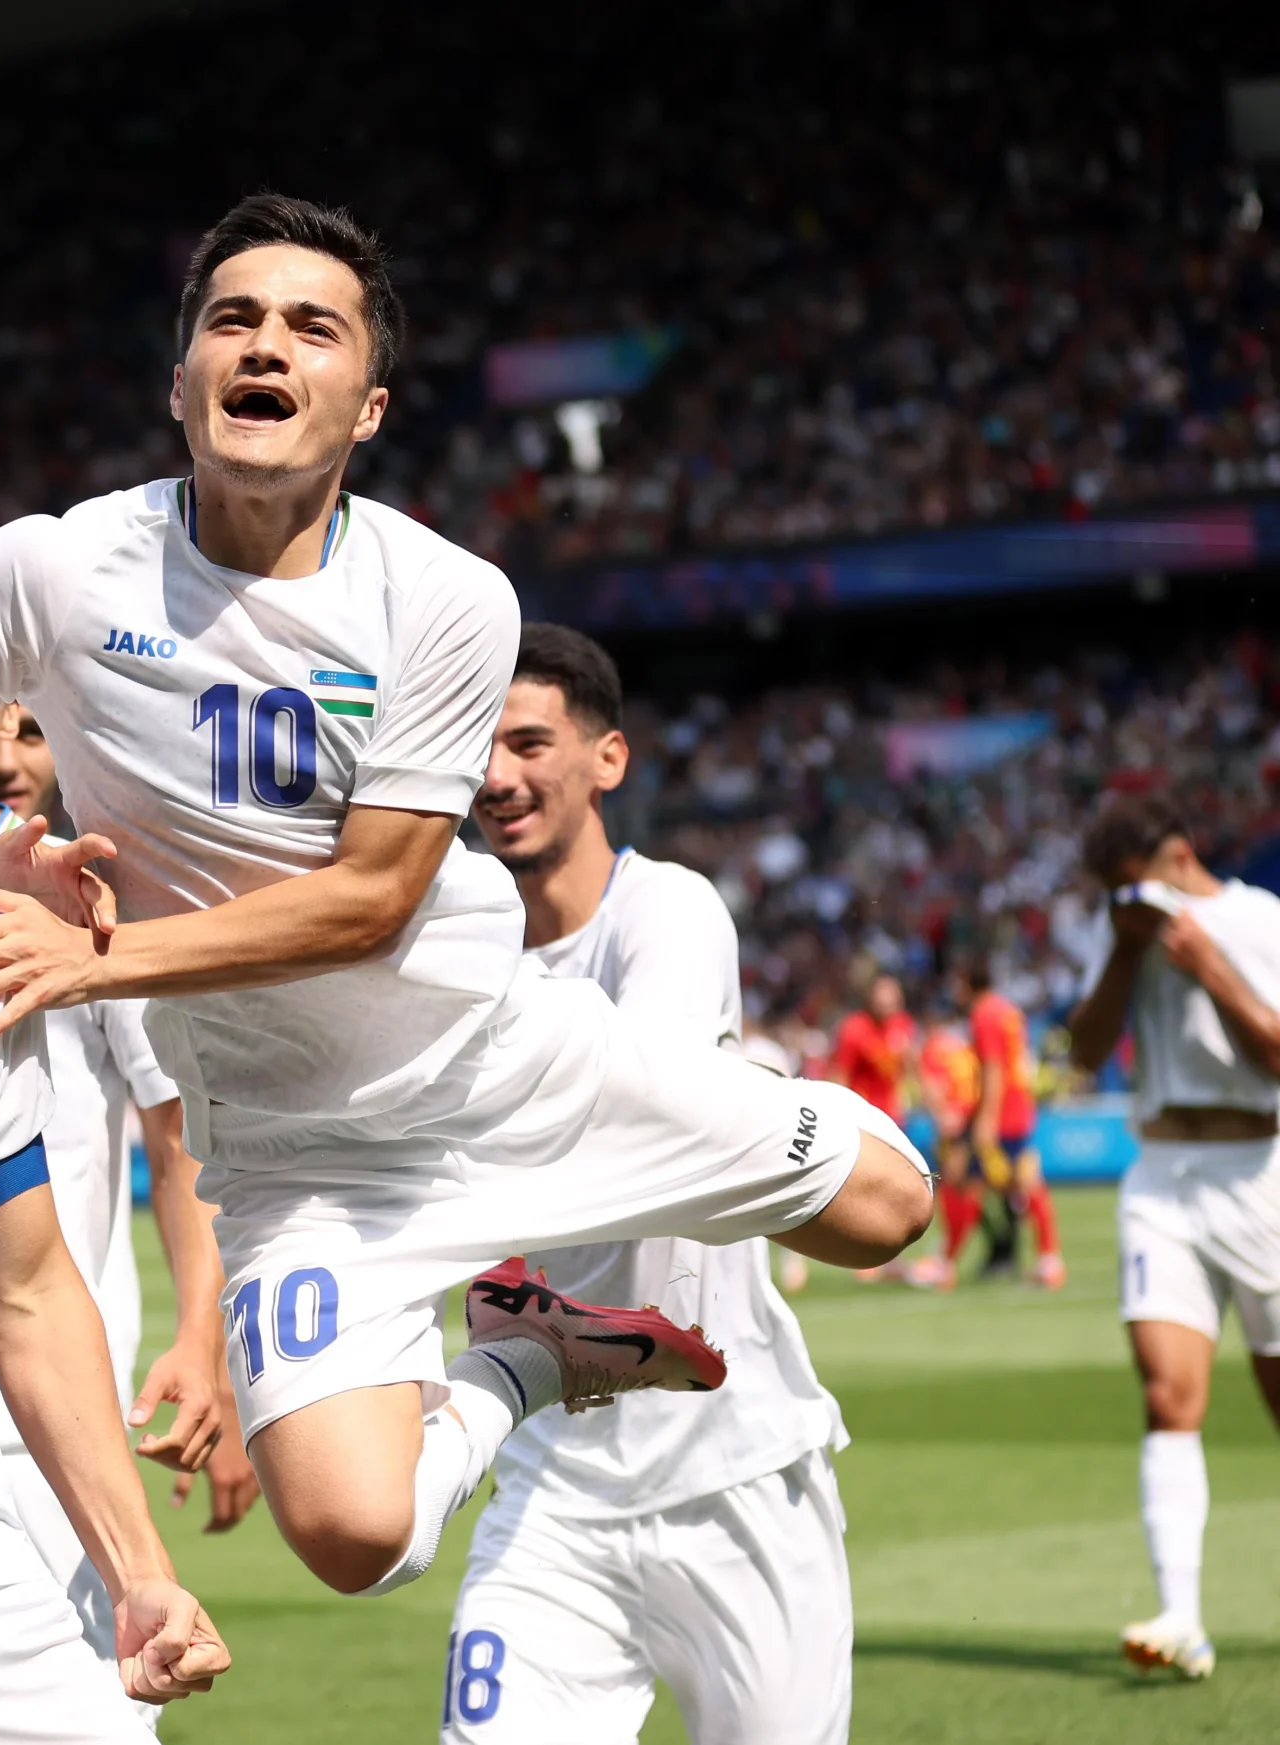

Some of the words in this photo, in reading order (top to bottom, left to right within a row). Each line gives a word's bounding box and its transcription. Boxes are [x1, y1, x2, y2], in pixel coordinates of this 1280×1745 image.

[104, 629, 178, 659] JAKO
[193, 683, 317, 809] 10
[787, 1106, 818, 1167] JAKO
[229, 1266, 339, 1387] 10
